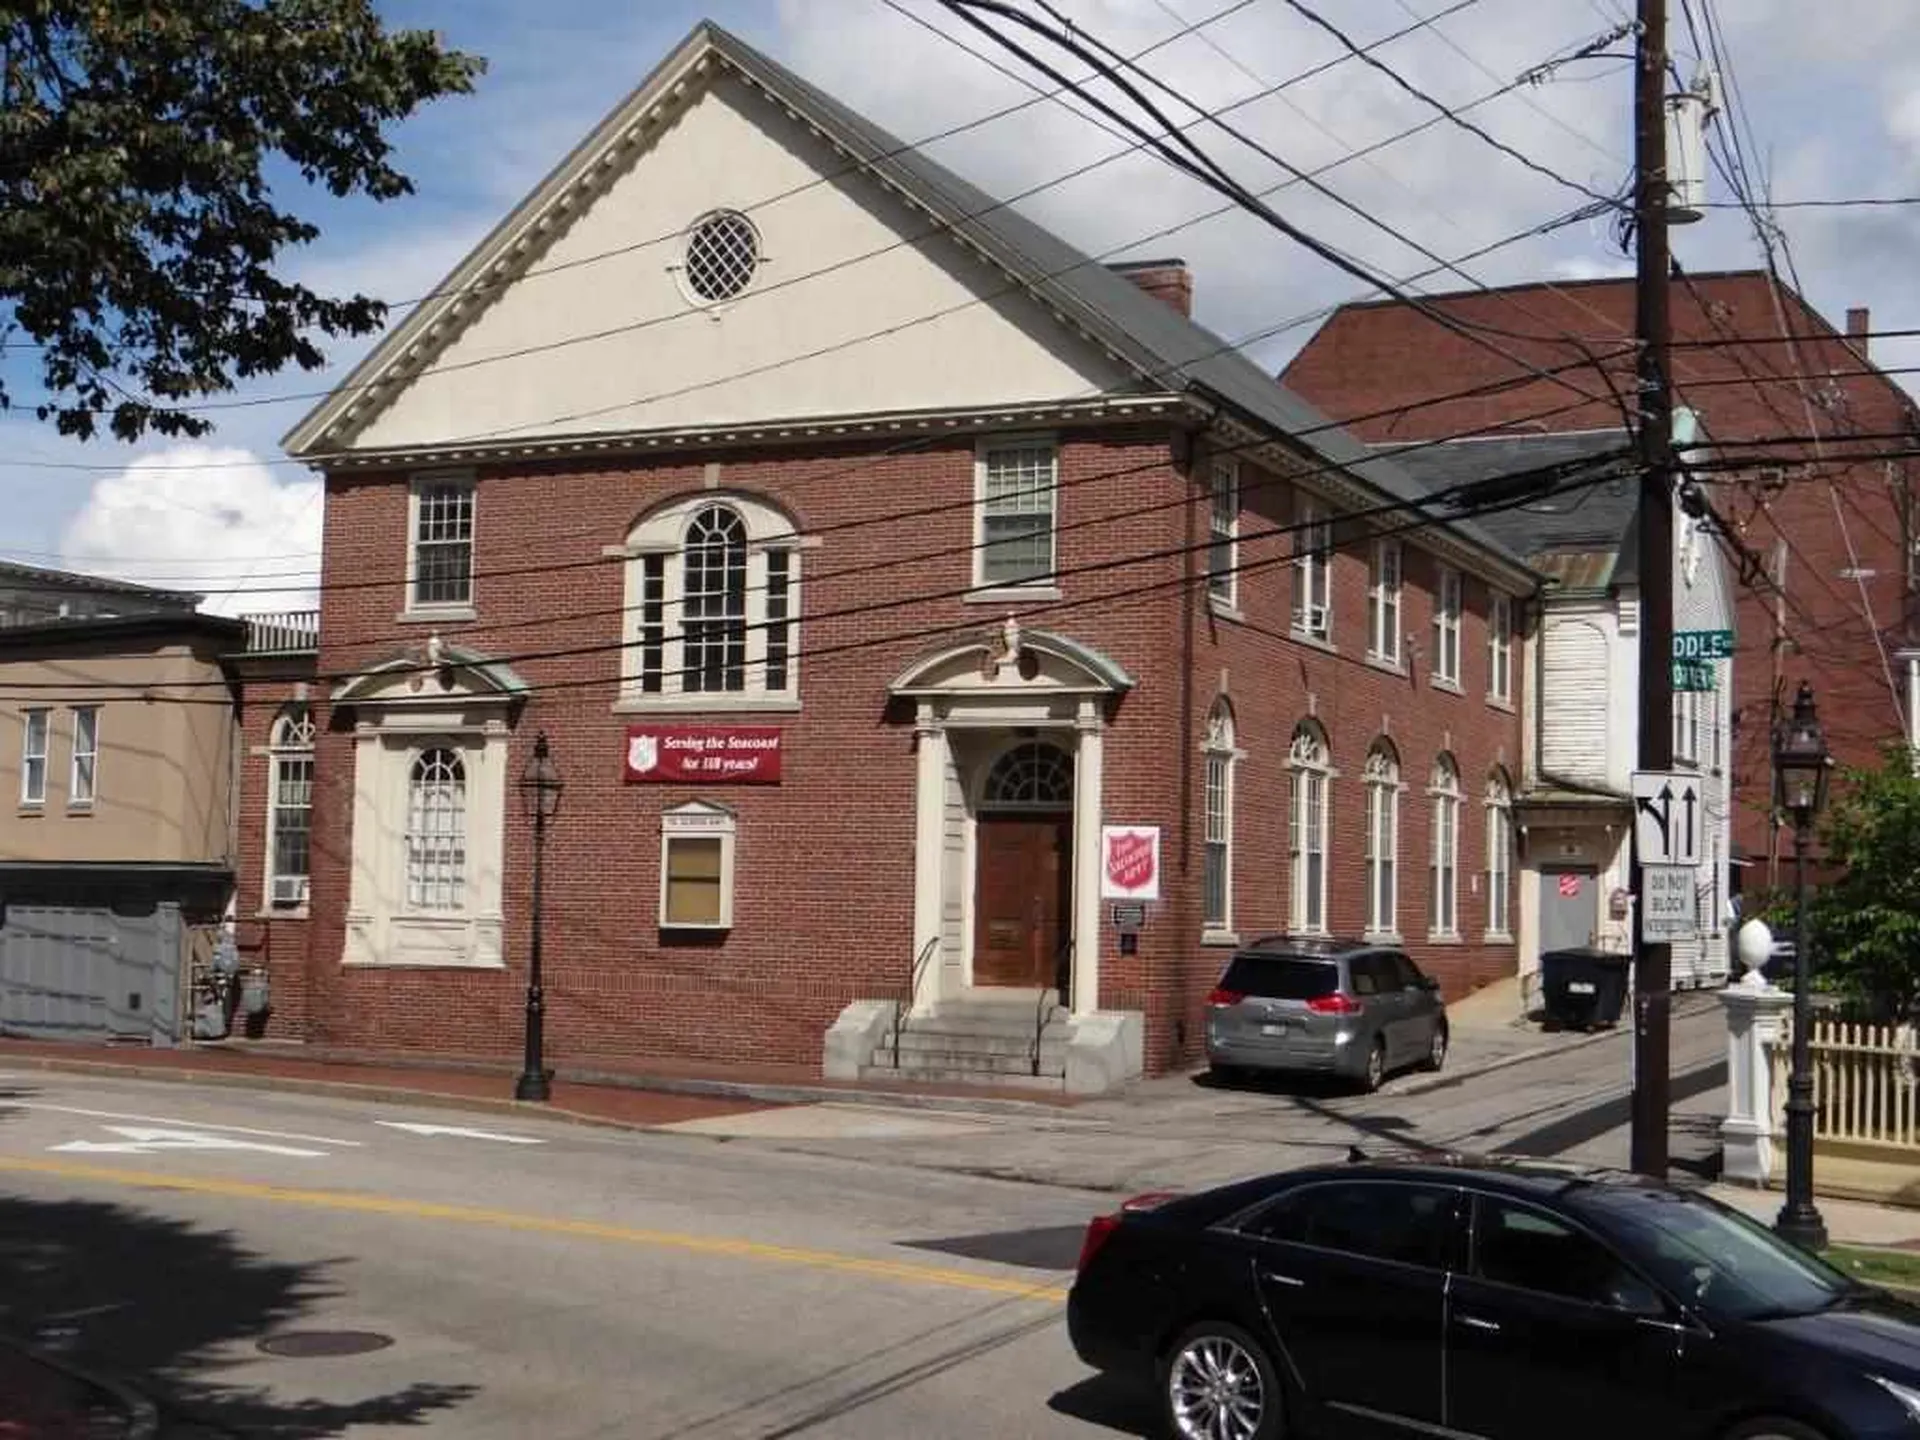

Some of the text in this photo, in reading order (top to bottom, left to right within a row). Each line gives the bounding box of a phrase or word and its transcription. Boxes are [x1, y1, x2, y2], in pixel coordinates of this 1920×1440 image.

[663, 735, 779, 752] Serving the Seacoast
[682, 756, 700, 770] for
